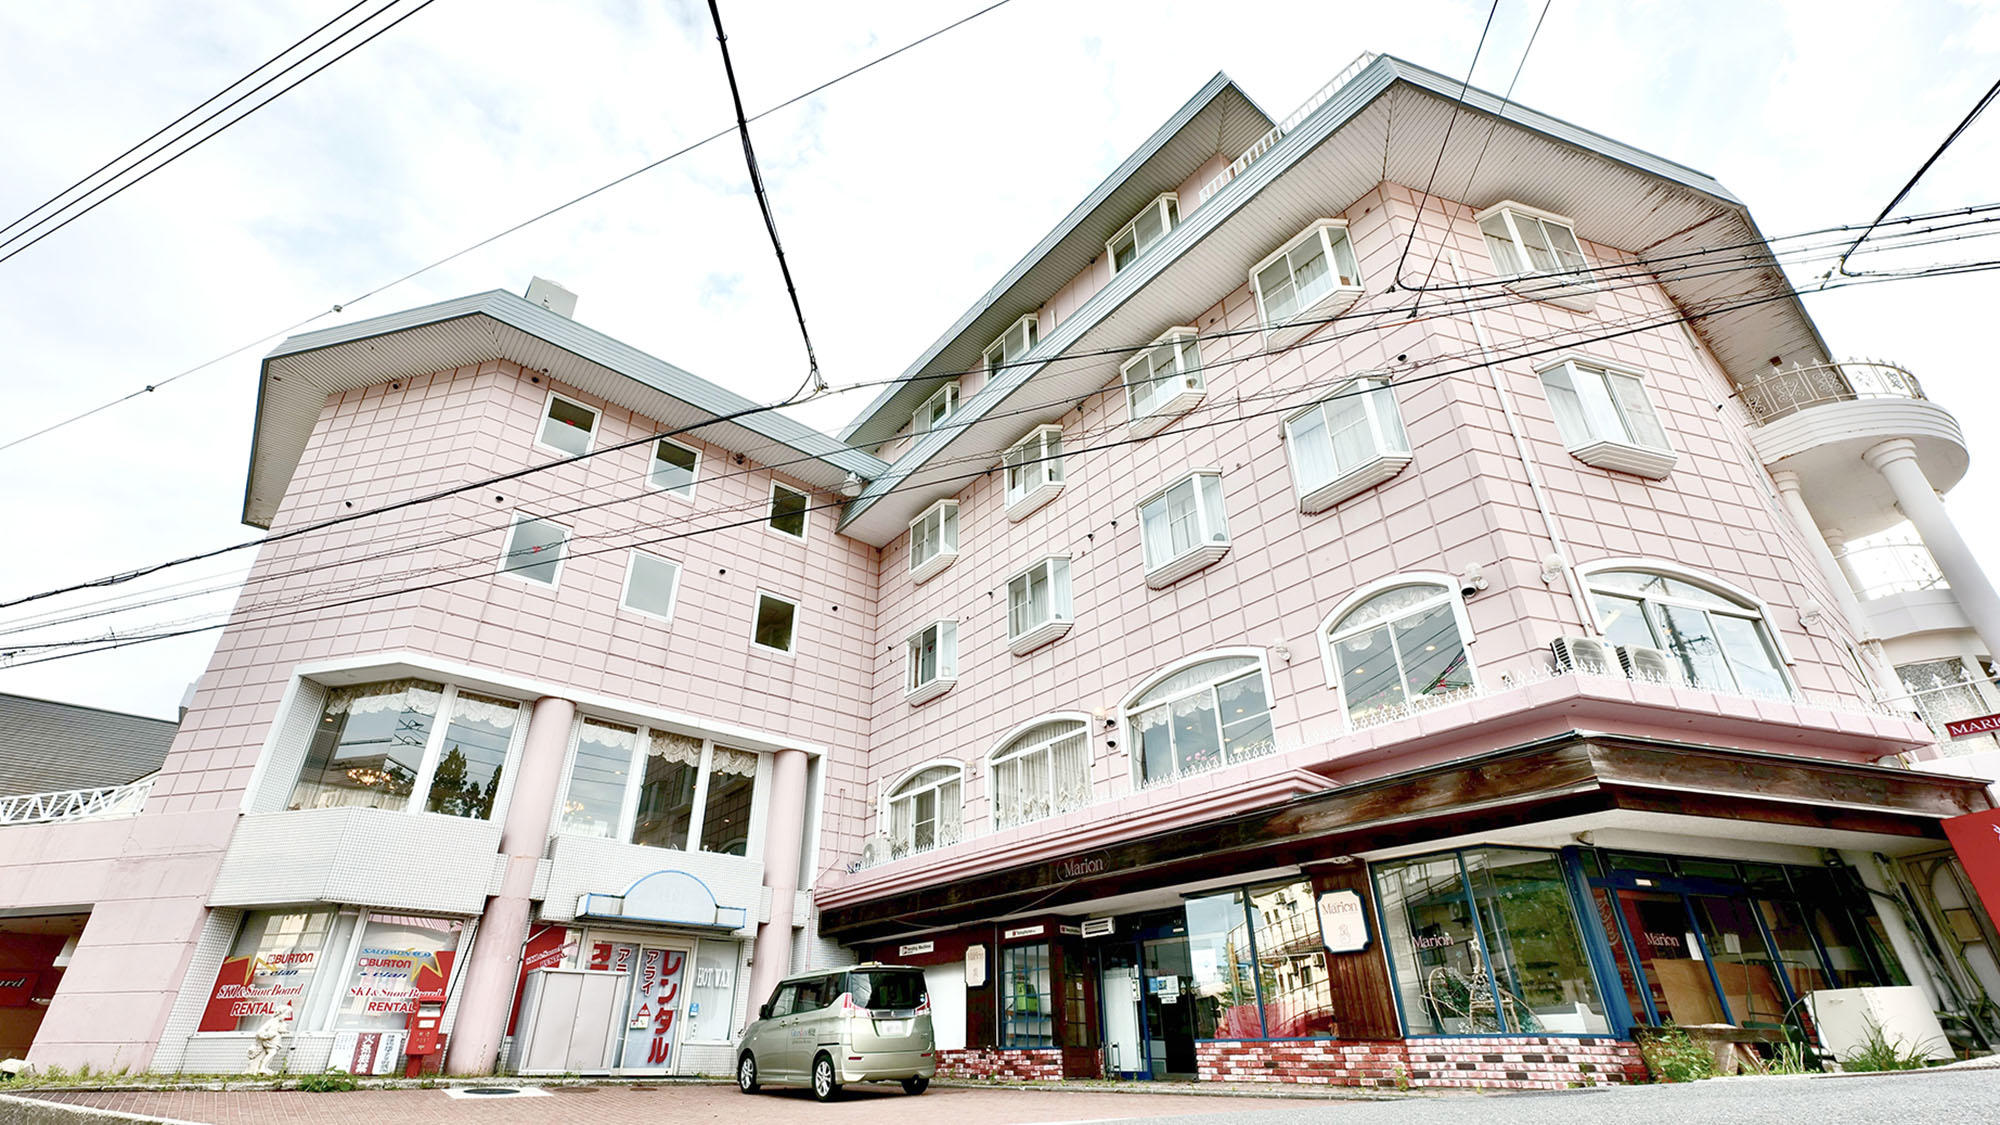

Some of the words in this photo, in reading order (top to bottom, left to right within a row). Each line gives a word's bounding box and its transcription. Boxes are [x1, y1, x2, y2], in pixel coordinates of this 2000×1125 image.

[1063, 858, 1104, 878] Marion
[1321, 901, 1359, 916] Marion
[1411, 933, 1455, 949] Marion
[1643, 931, 1680, 947] Marion
[274, 952, 314, 965] BURTON
[368, 958, 412, 968] BURTON
[641, 950, 660, 996] アライ
[696, 967, 714, 987] HOT
[230, 1001, 275, 1016] RENTAL
[367, 1001, 415, 1013] RENTAL
[647, 950, 682, 1064] レンタル
